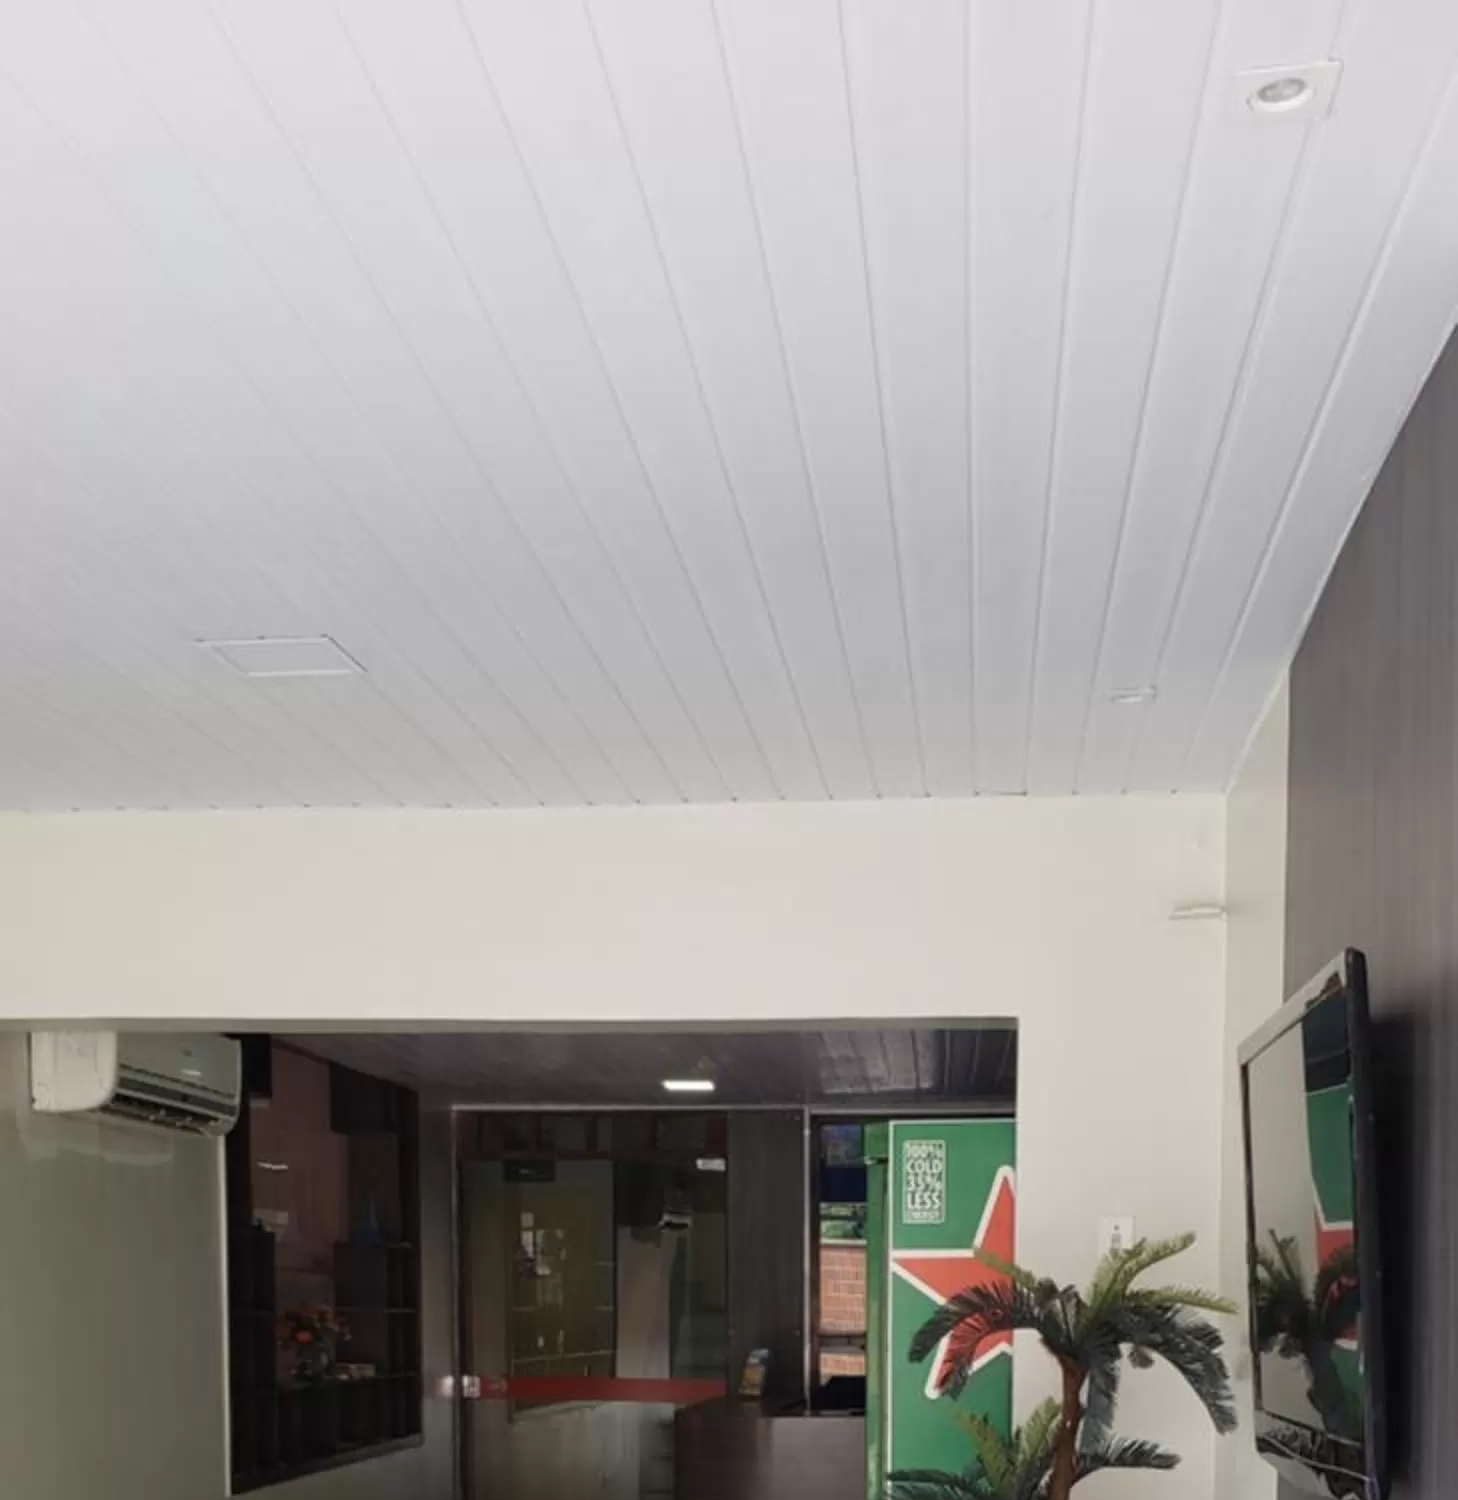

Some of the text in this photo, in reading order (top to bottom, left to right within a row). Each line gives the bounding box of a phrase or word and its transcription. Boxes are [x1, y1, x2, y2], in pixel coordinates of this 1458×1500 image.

[906, 1160, 942, 1173] COLD
[907, 1176, 942, 1192] 35%
[907, 1193, 941, 1209] LESS
